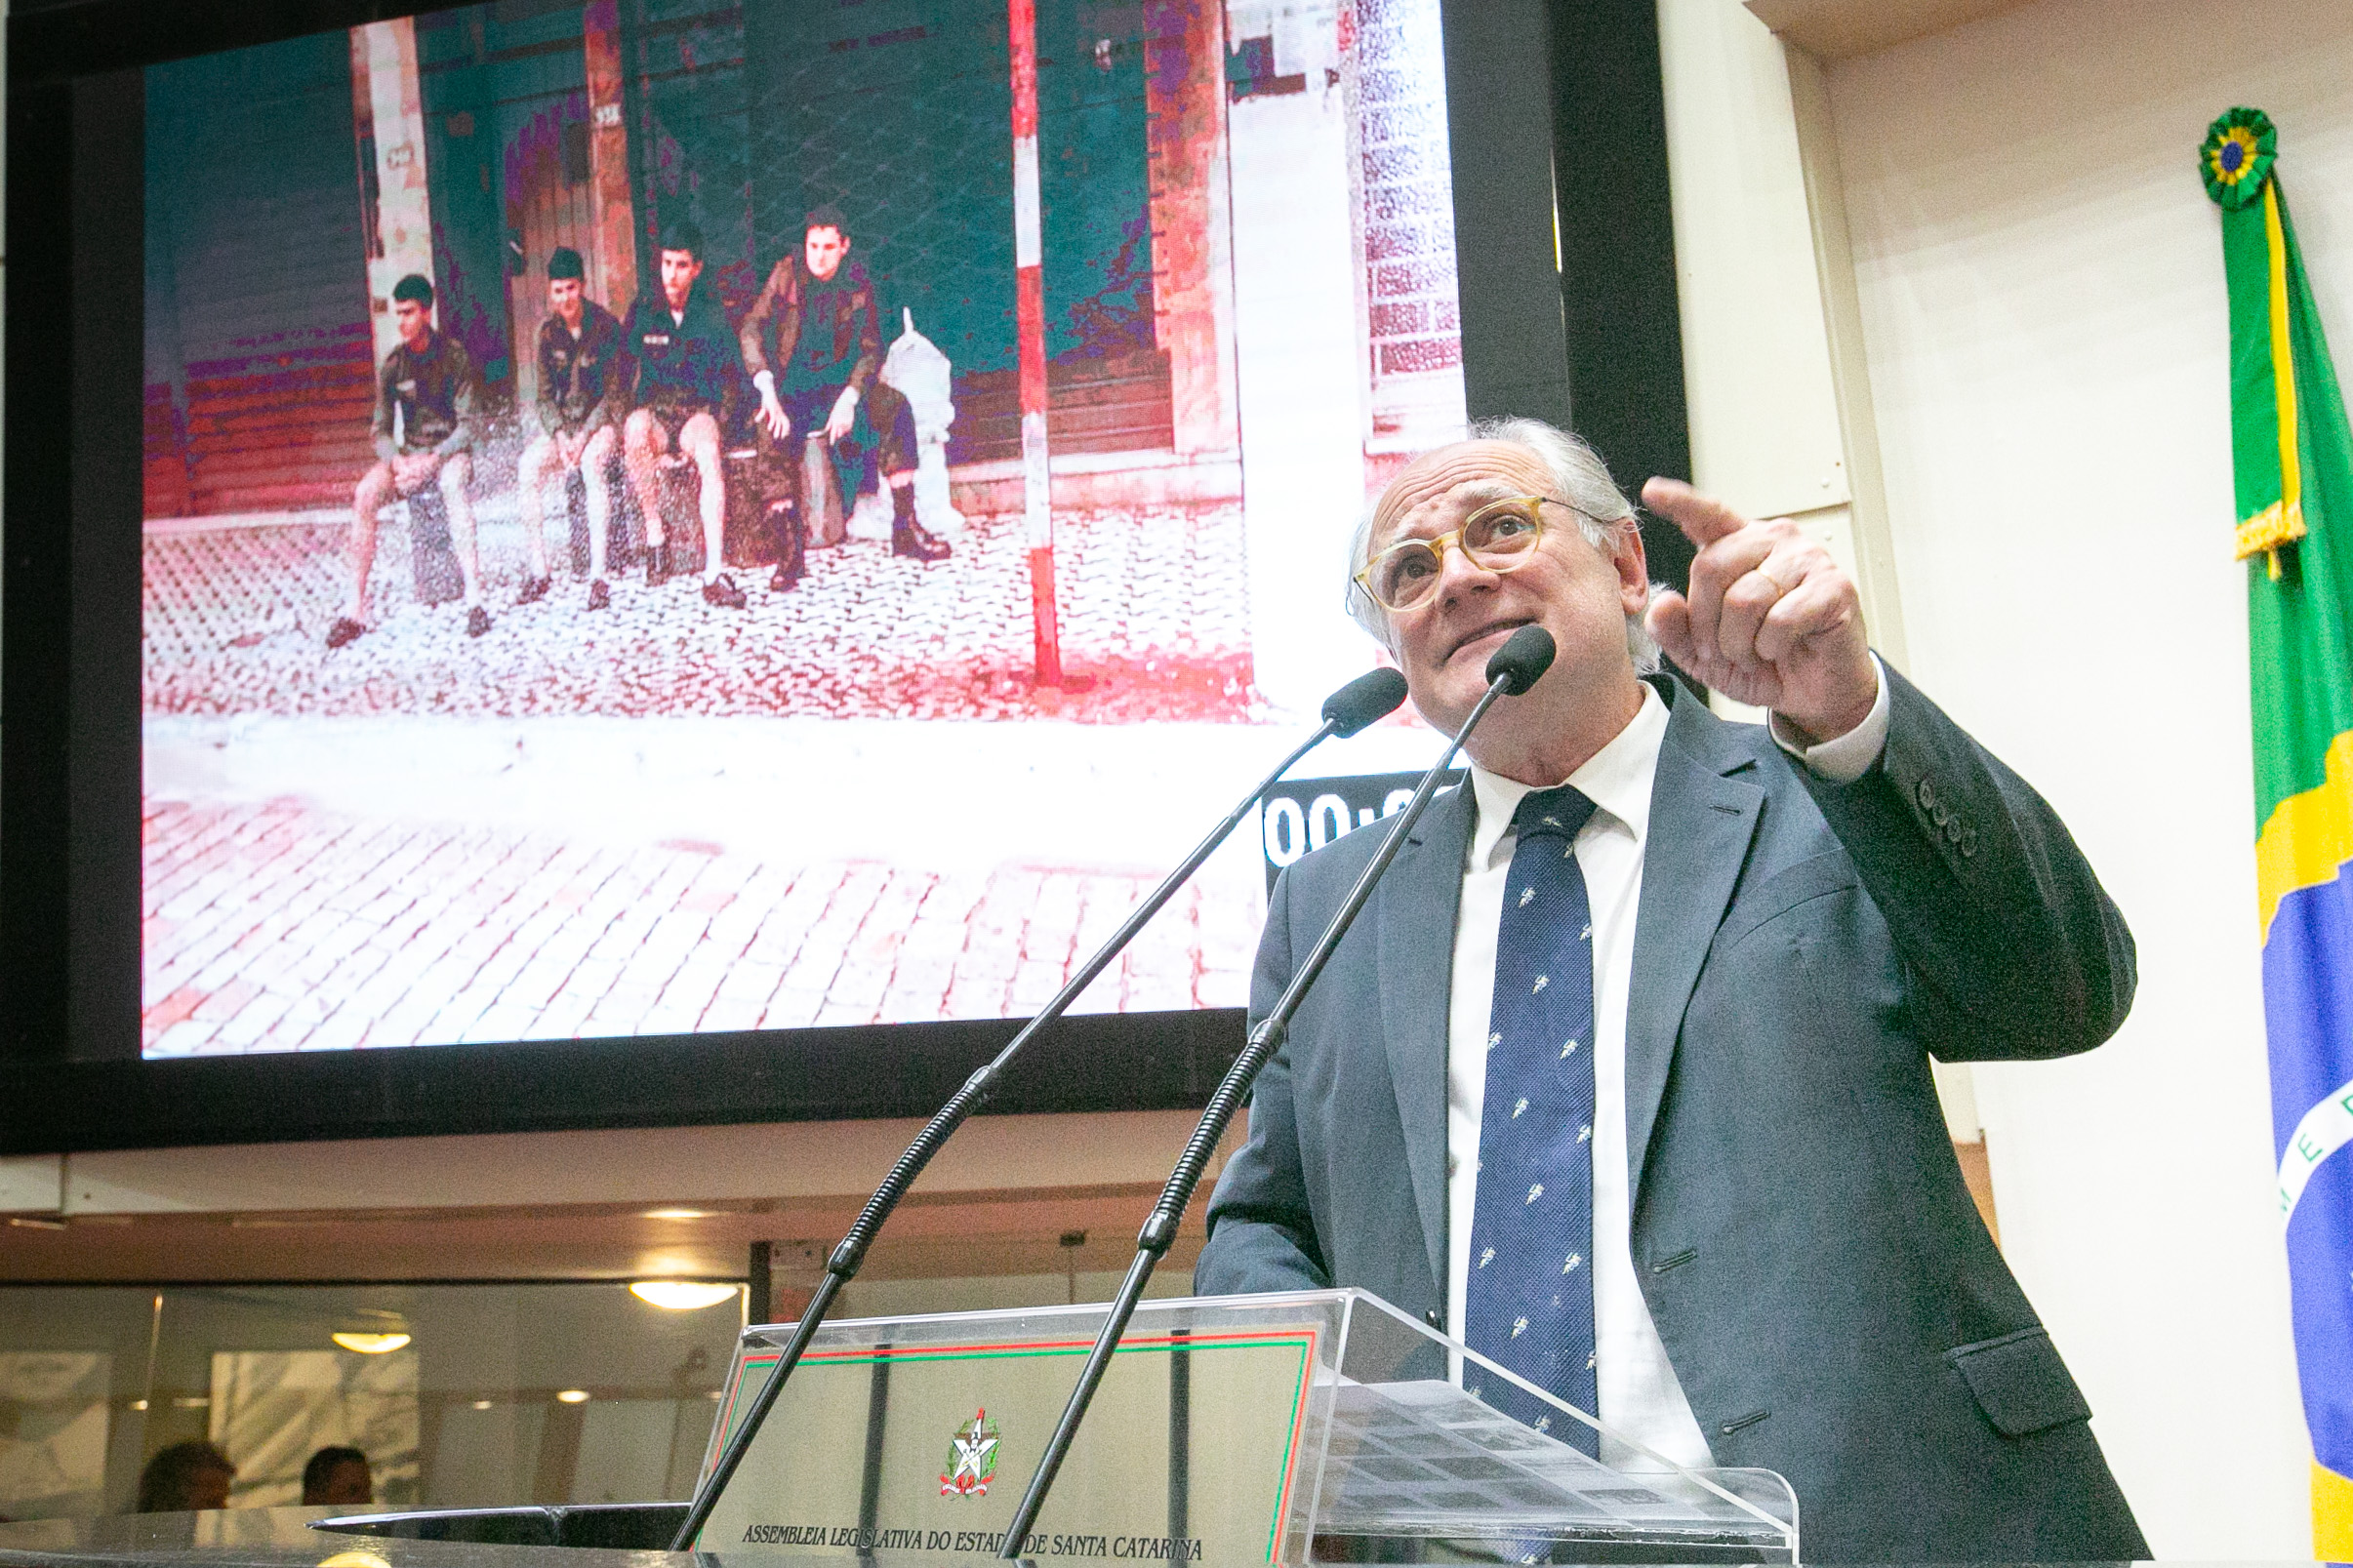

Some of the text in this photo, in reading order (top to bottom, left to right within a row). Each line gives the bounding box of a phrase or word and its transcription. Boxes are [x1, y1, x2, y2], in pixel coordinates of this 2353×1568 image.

[2297, 1133, 2324, 1163] E
[743, 1525, 1202, 1560] ASSEMBLEIA LEGISLATIVA DO ESTA DE SANTA CATARINA
